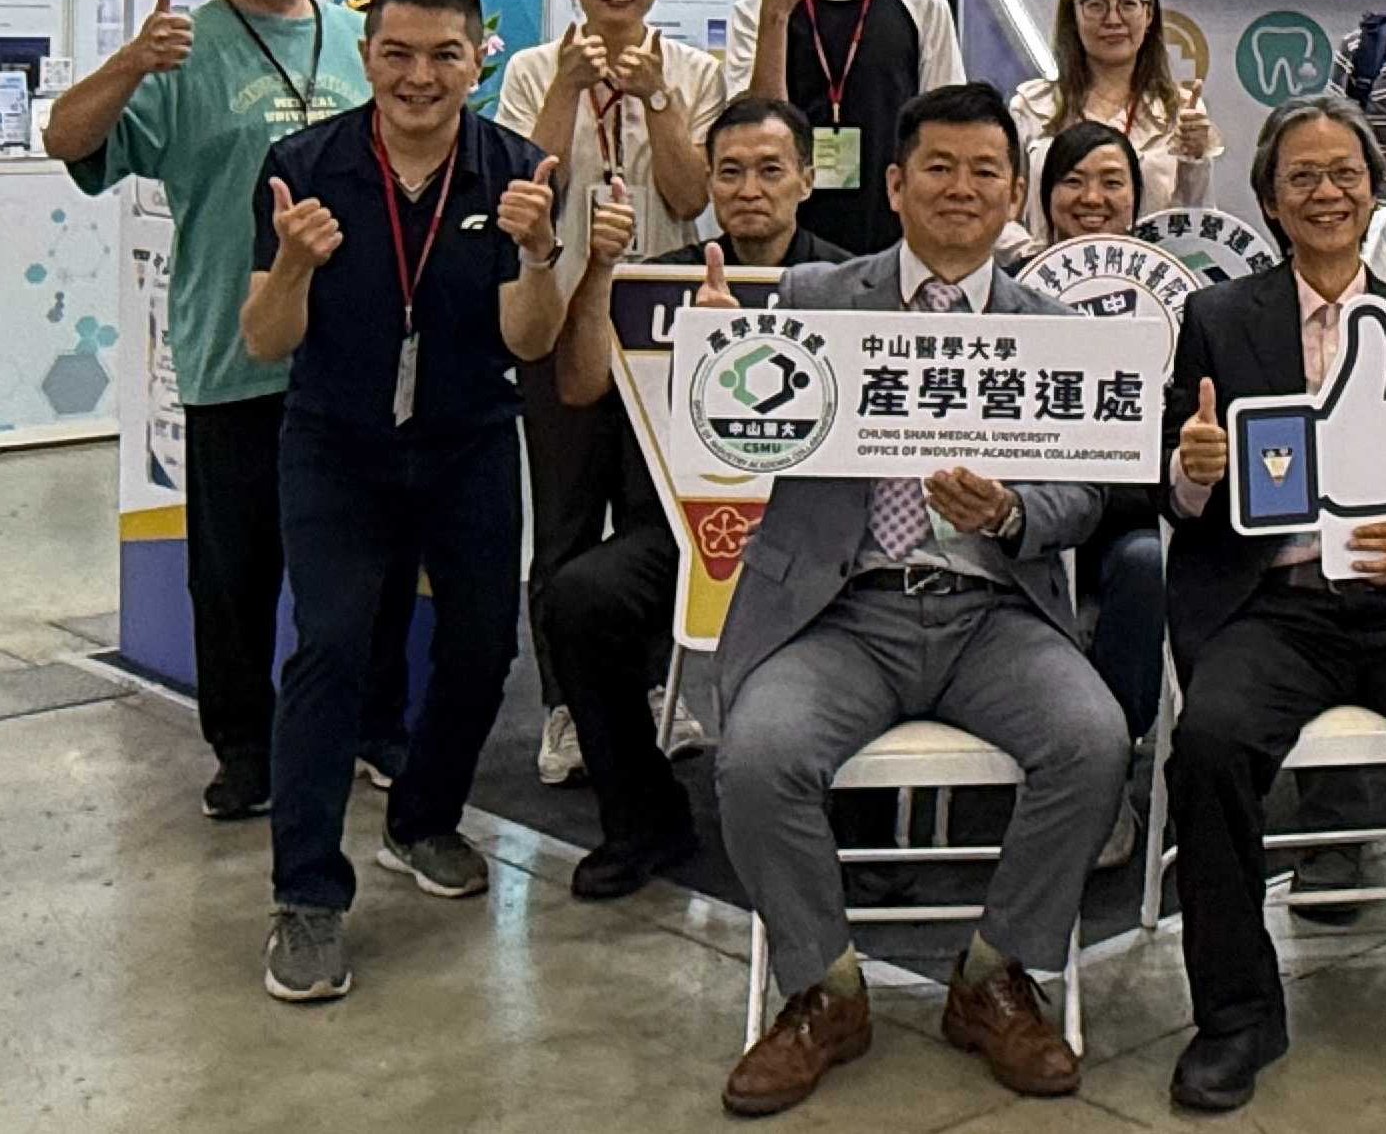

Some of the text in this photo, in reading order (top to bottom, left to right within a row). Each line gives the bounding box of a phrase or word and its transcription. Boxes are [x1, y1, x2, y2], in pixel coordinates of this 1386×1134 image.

[861, 334, 1018, 362] 中山醫學大學
[856, 364, 1143, 422] 產學營運處
[857, 428, 1061, 443] CHUNG SHAN MEDICAL UNIVERSITY
[742, 442, 782, 454] CSMU
[857, 444, 1141, 461] OFFICE OF INDUSTRY-ACADEMIA COLLABORATION
